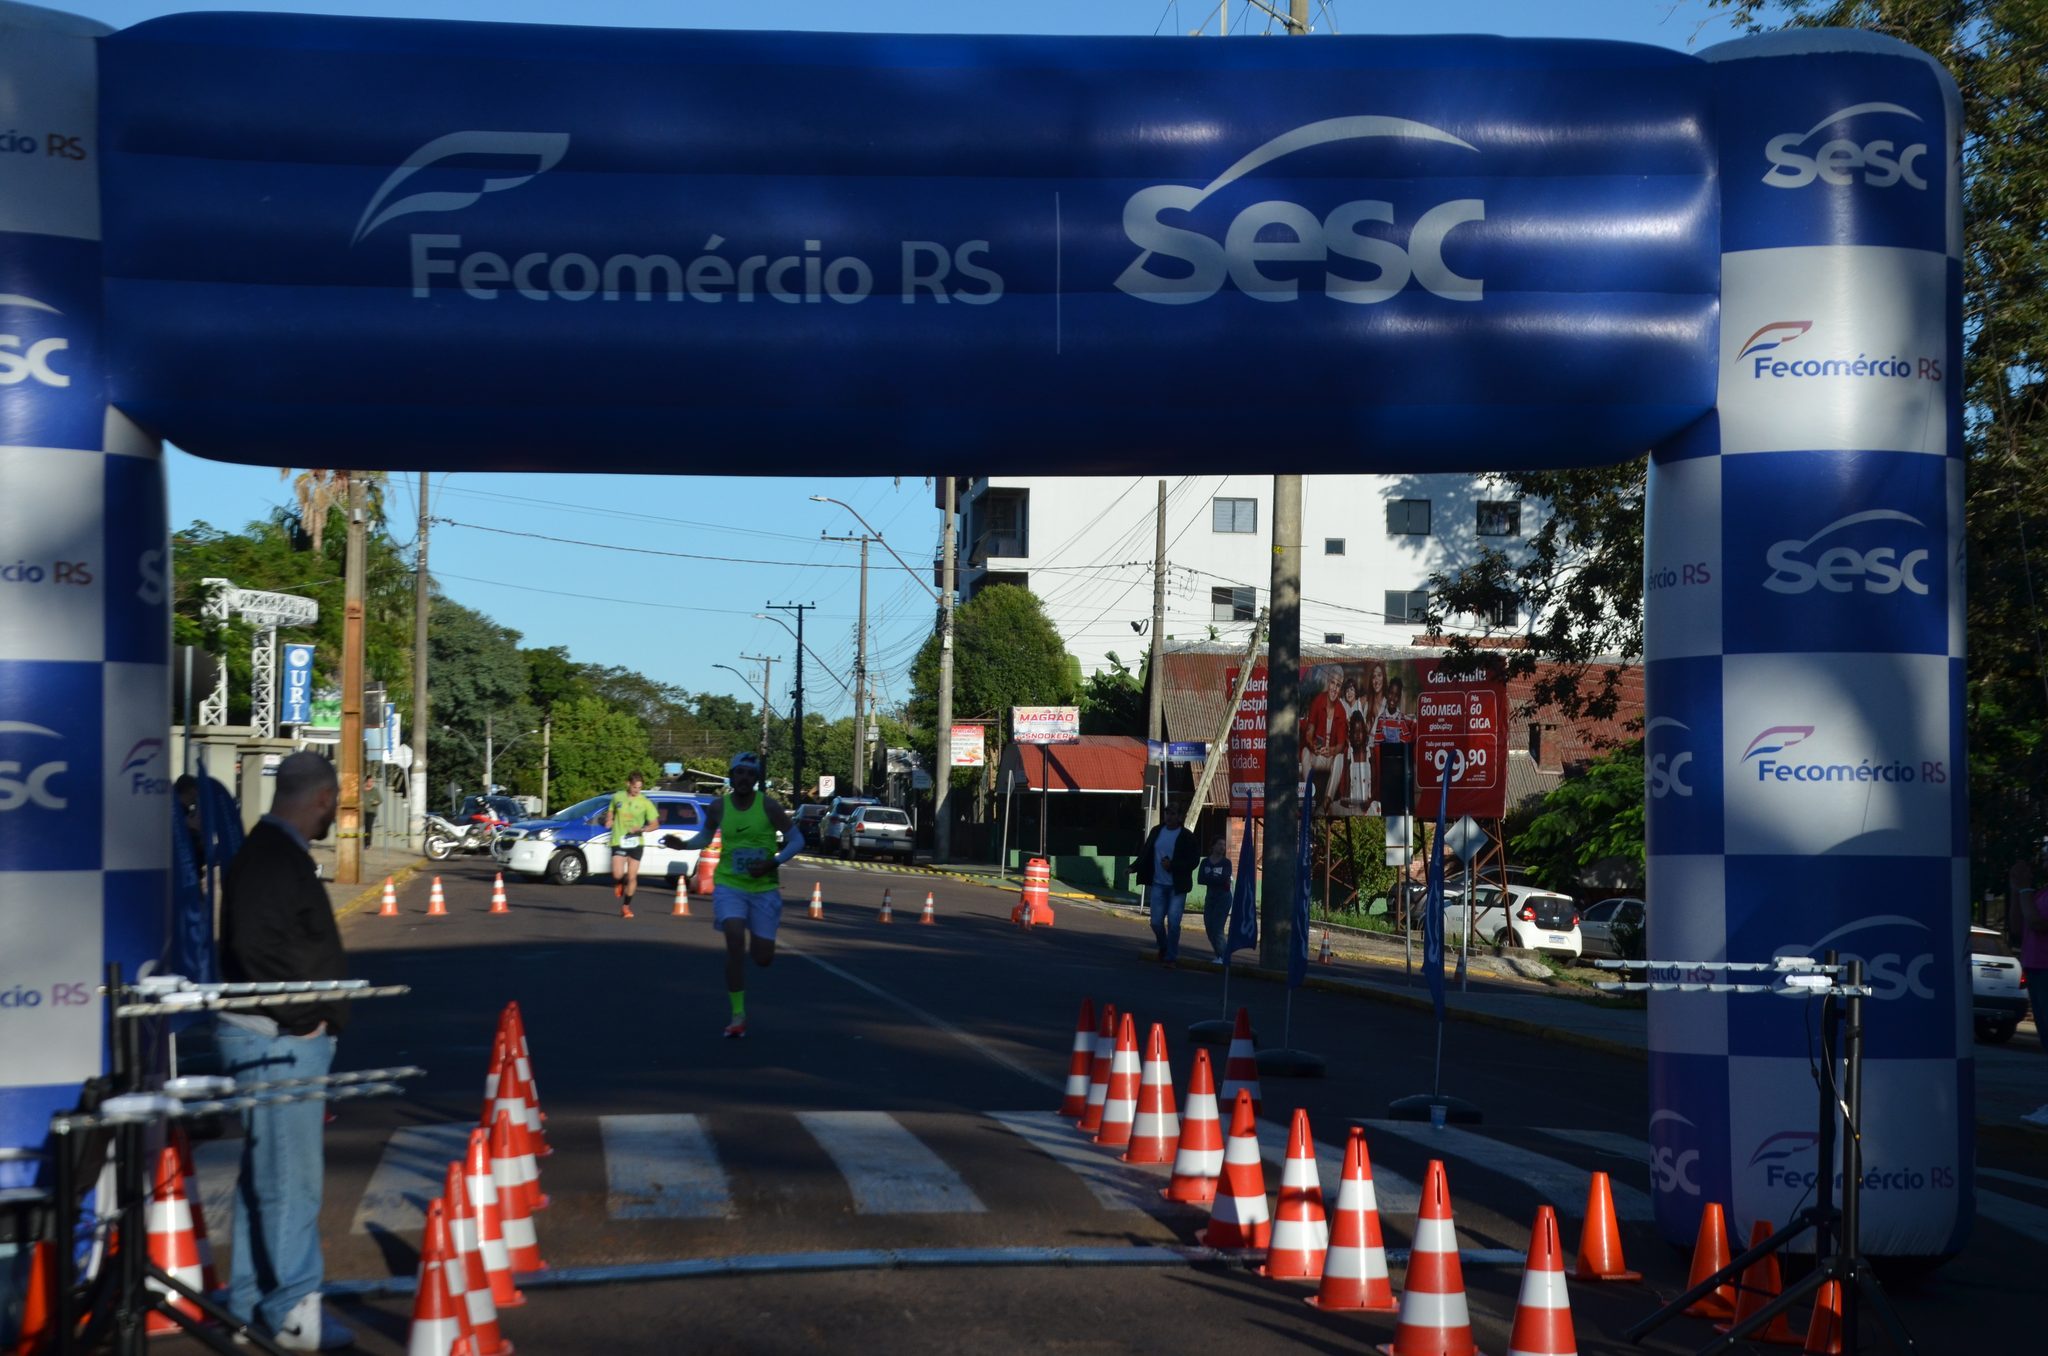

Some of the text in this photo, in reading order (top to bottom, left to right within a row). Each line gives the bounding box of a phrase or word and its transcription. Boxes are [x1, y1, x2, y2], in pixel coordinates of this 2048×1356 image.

[47, 132, 86, 160] RS
[1761, 133, 1928, 190] Sesc
[1112, 184, 1486, 305] Sesc
[408, 233, 1005, 305] Fecomércio RS
[1754, 354, 1943, 381] Fecomércio RS
[53, 561, 94, 585] RS
[1682, 562, 1711, 585] RS
[1762, 539, 1929, 595] Sesc
[289, 670, 308, 721] URI
[1421, 704, 1462, 717] 600 MEGA
[1470, 703, 1482, 715] 60
[1469, 717, 1491, 729] GIGA
[1231, 736, 1239, 749] tá
[1240, 738, 1251, 750] na
[1231, 753, 1261, 769] cidade.
[1758, 759, 1947, 784] Fecomércio RS
[51, 982, 90, 1008] RS
[1931, 1167, 1954, 1189] RS
